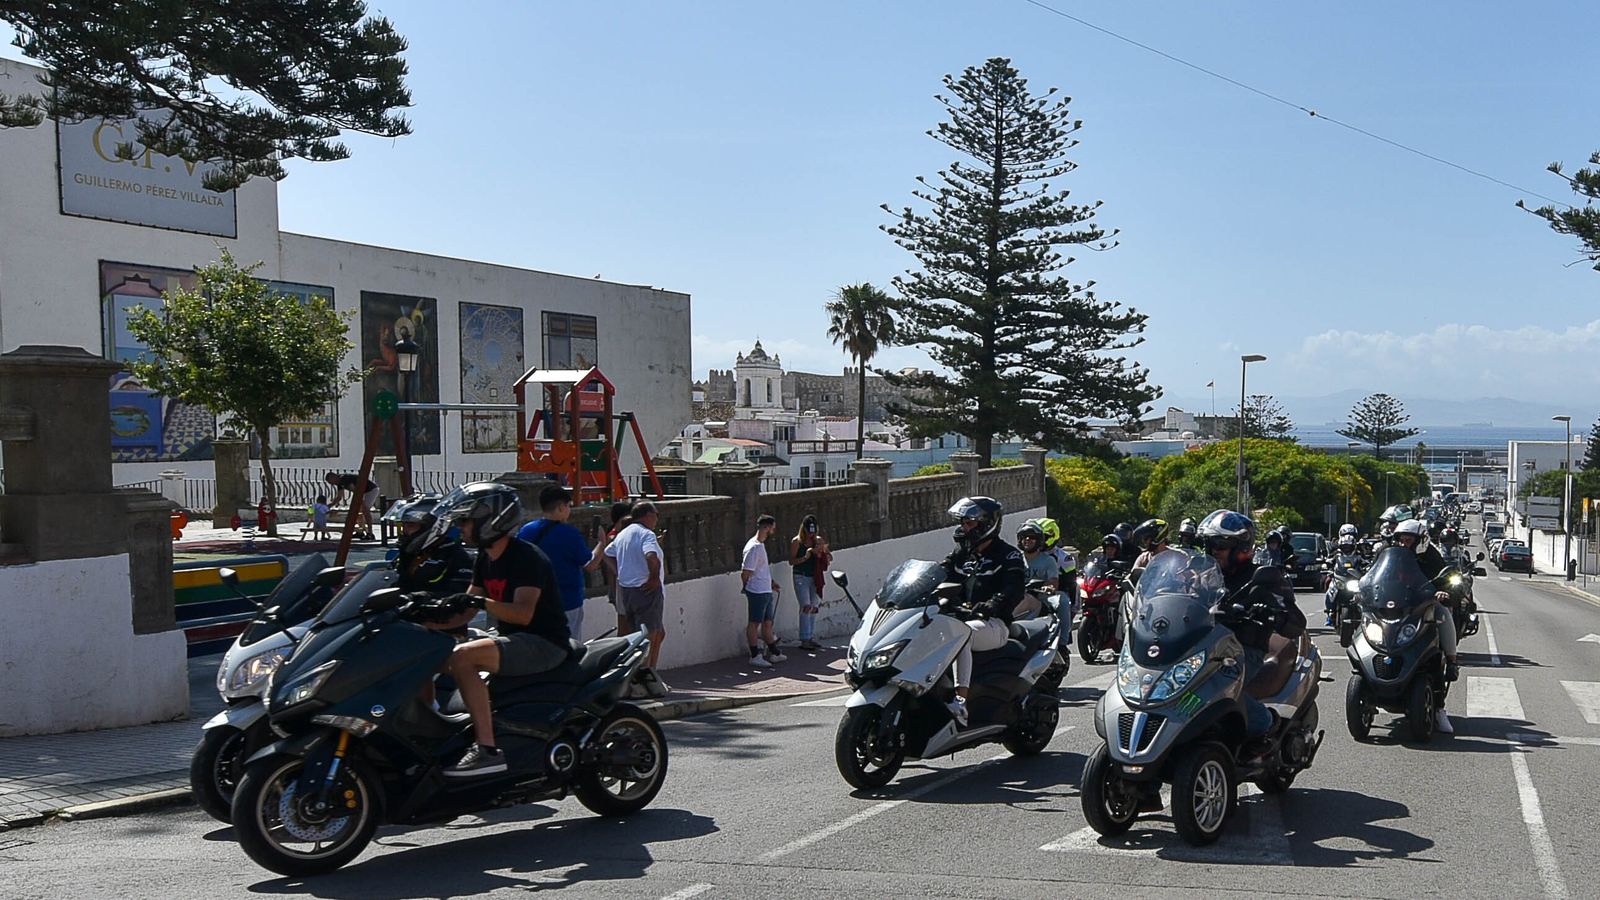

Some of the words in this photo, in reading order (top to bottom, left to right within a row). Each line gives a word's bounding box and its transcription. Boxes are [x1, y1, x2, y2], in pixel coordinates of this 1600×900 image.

[73, 172, 142, 194] GUILLERMO
[146, 183, 177, 199] PÉREZ
[180, 190, 224, 207] VILLALTA
